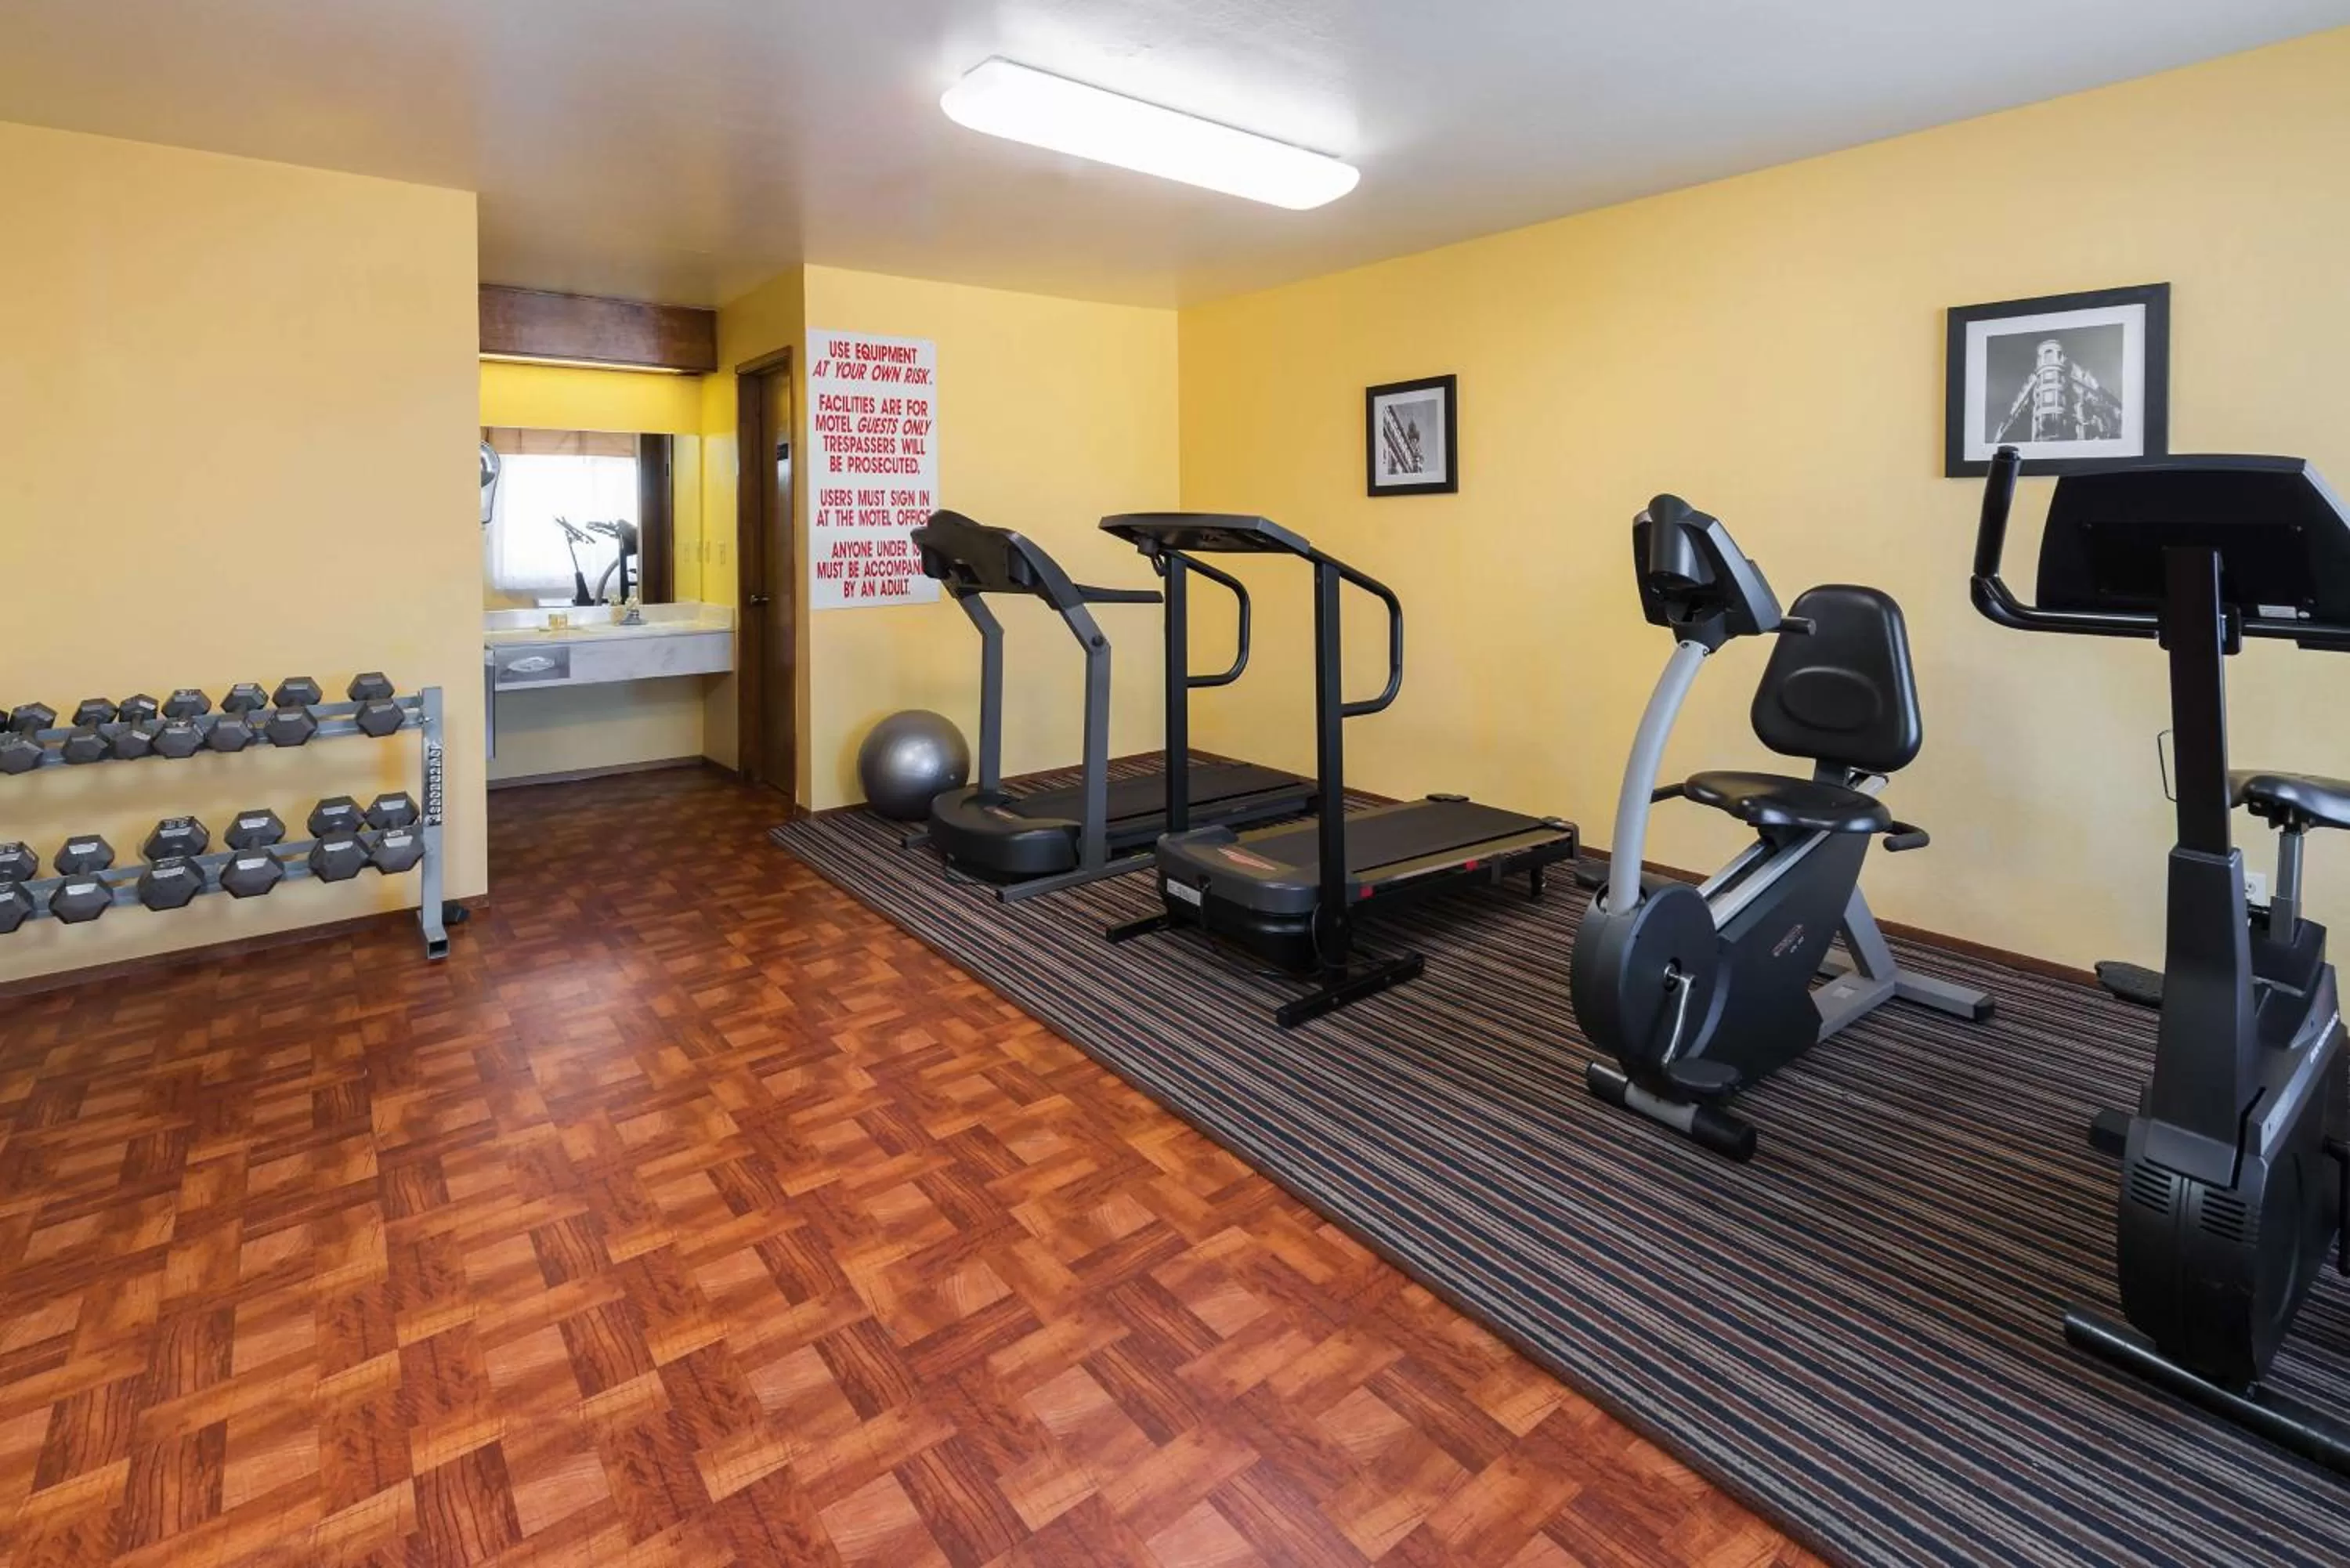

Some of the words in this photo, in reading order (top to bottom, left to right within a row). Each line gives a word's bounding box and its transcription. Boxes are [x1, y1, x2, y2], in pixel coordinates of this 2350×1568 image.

[829, 340, 851, 359] USE
[855, 342, 917, 365] EQUIPMENT
[812, 359, 830, 377] AT
[835, 361, 867, 381] YOUR
[871, 364, 902, 383] OWN
[819, 394, 876, 414] FACILITIES
[880, 398, 902, 416] ARE
[906, 399, 928, 417] FOR
[815, 414, 852, 433] MOTEL
[858, 417, 898, 435] GUESTS
[902, 419, 931, 437] ONLY
[823, 435, 896, 454] TRESPASSERS
[901, 438, 927, 456] WILL
[830, 455, 843, 472] BE
[820, 488, 854, 507] USERS
[858, 490, 886, 507] MUST
[890, 490, 916, 507] SIGN
[918, 490, 931, 507] IN
[816, 509, 830, 527] AT
[836, 509, 855, 527] THE
[859, 510, 892, 527] MOTEL
[831, 540, 873, 559] ANYONE
[877, 540, 909, 558] UNDER
[817, 562, 844, 580] MUST
[848, 561, 860, 579] BE
[844, 581, 856, 598] BY
[861, 580, 877, 598] AN
[880, 579, 911, 597] ADULT.
